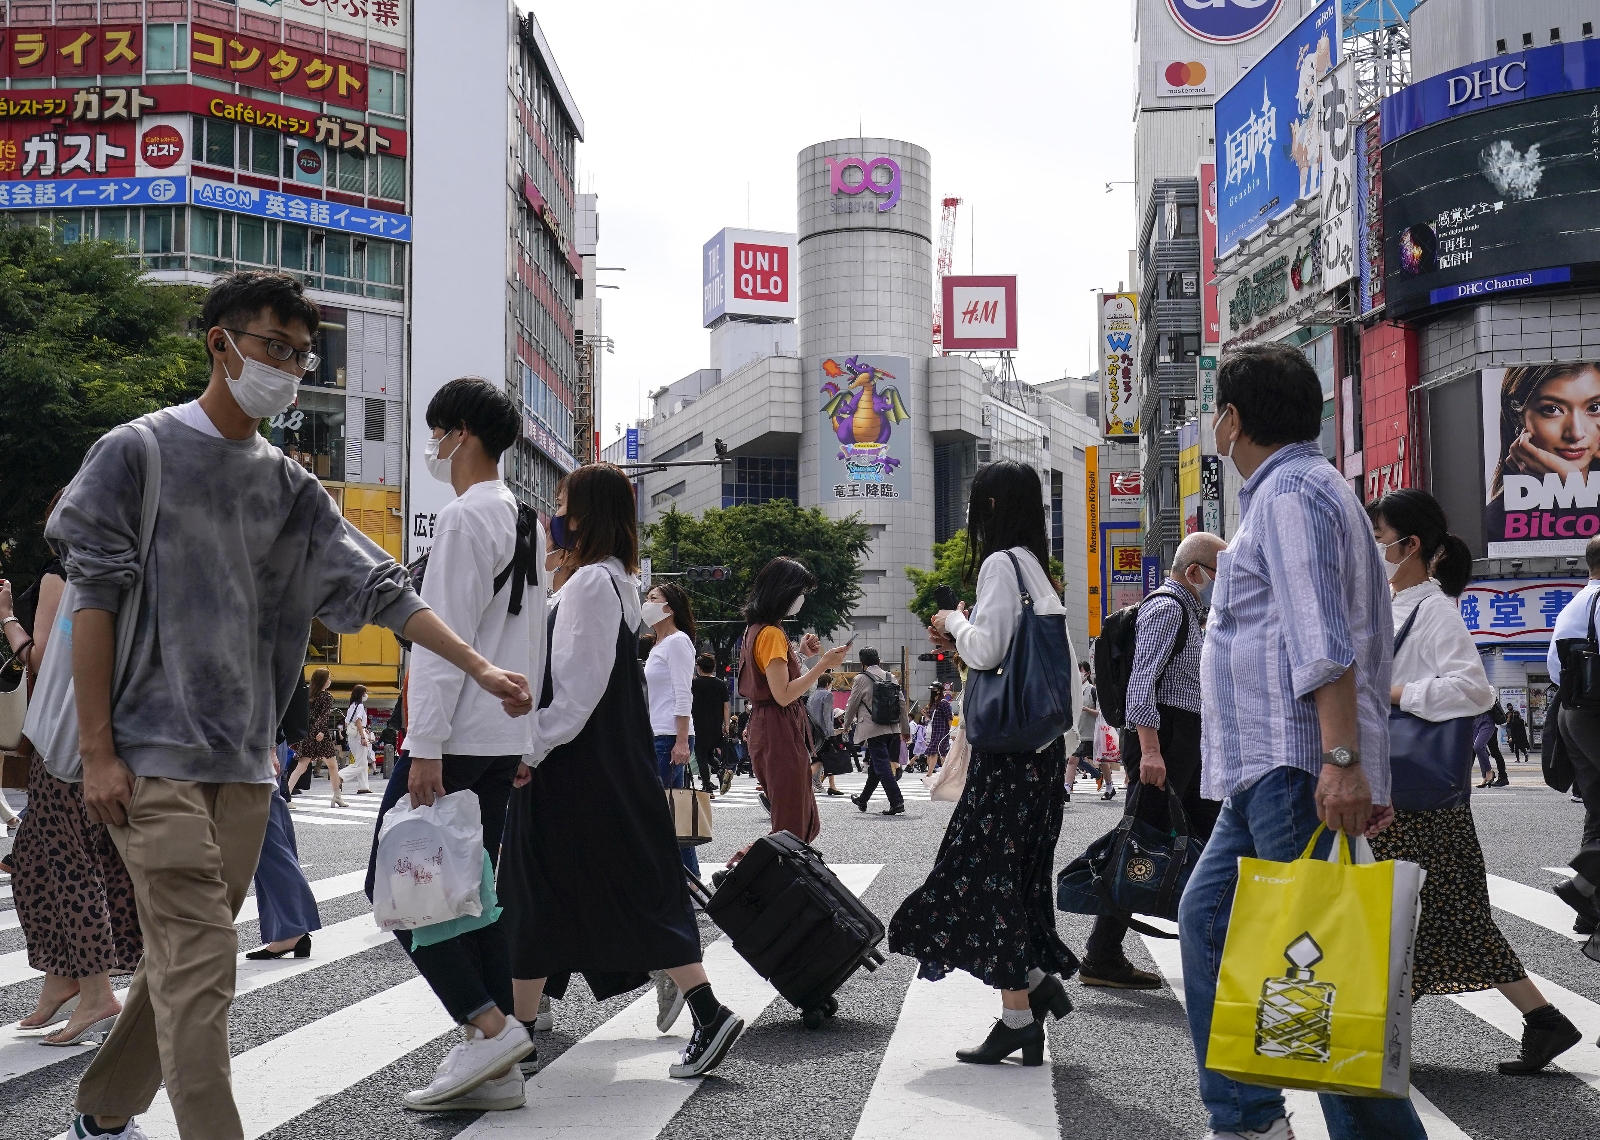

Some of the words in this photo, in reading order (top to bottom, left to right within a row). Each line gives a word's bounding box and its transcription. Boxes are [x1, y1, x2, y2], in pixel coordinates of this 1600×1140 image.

[13, 30, 138, 68] ライス
[193, 31, 364, 97] コンタクト
[1166, 87, 1207, 95] mastercard
[1447, 60, 1527, 107] DHC
[73, 87, 155, 120] ガスト
[314, 116, 391, 156] ガスト
[22, 133, 126, 177] ガスト
[146, 144, 180, 157] ガスト
[824, 156, 902, 213] 109
[1322, 74, 1353, 276] もんじゃ
[151, 183, 173, 199] 6F
[201, 184, 251, 208] AEON
[265, 193, 407, 236] 英会話イーオン
[830, 201, 875, 213] SHIBUYA
[708, 243, 720, 280] THE
[740, 249, 778, 272] UNI
[1439, 250, 1473, 270] 配信中
[740, 273, 783, 297] QLO
[1458, 282, 1483, 297] DHC
[1485, 274, 1533, 291] Channel
[961, 300, 999, 325] H&M
[833, 483, 900, 499] 竜王、降臨。
[1089, 503, 1097, 554] Matsumoto
[1504, 511, 1600, 539] Bitco
[1119, 548, 1142, 569] 薬
